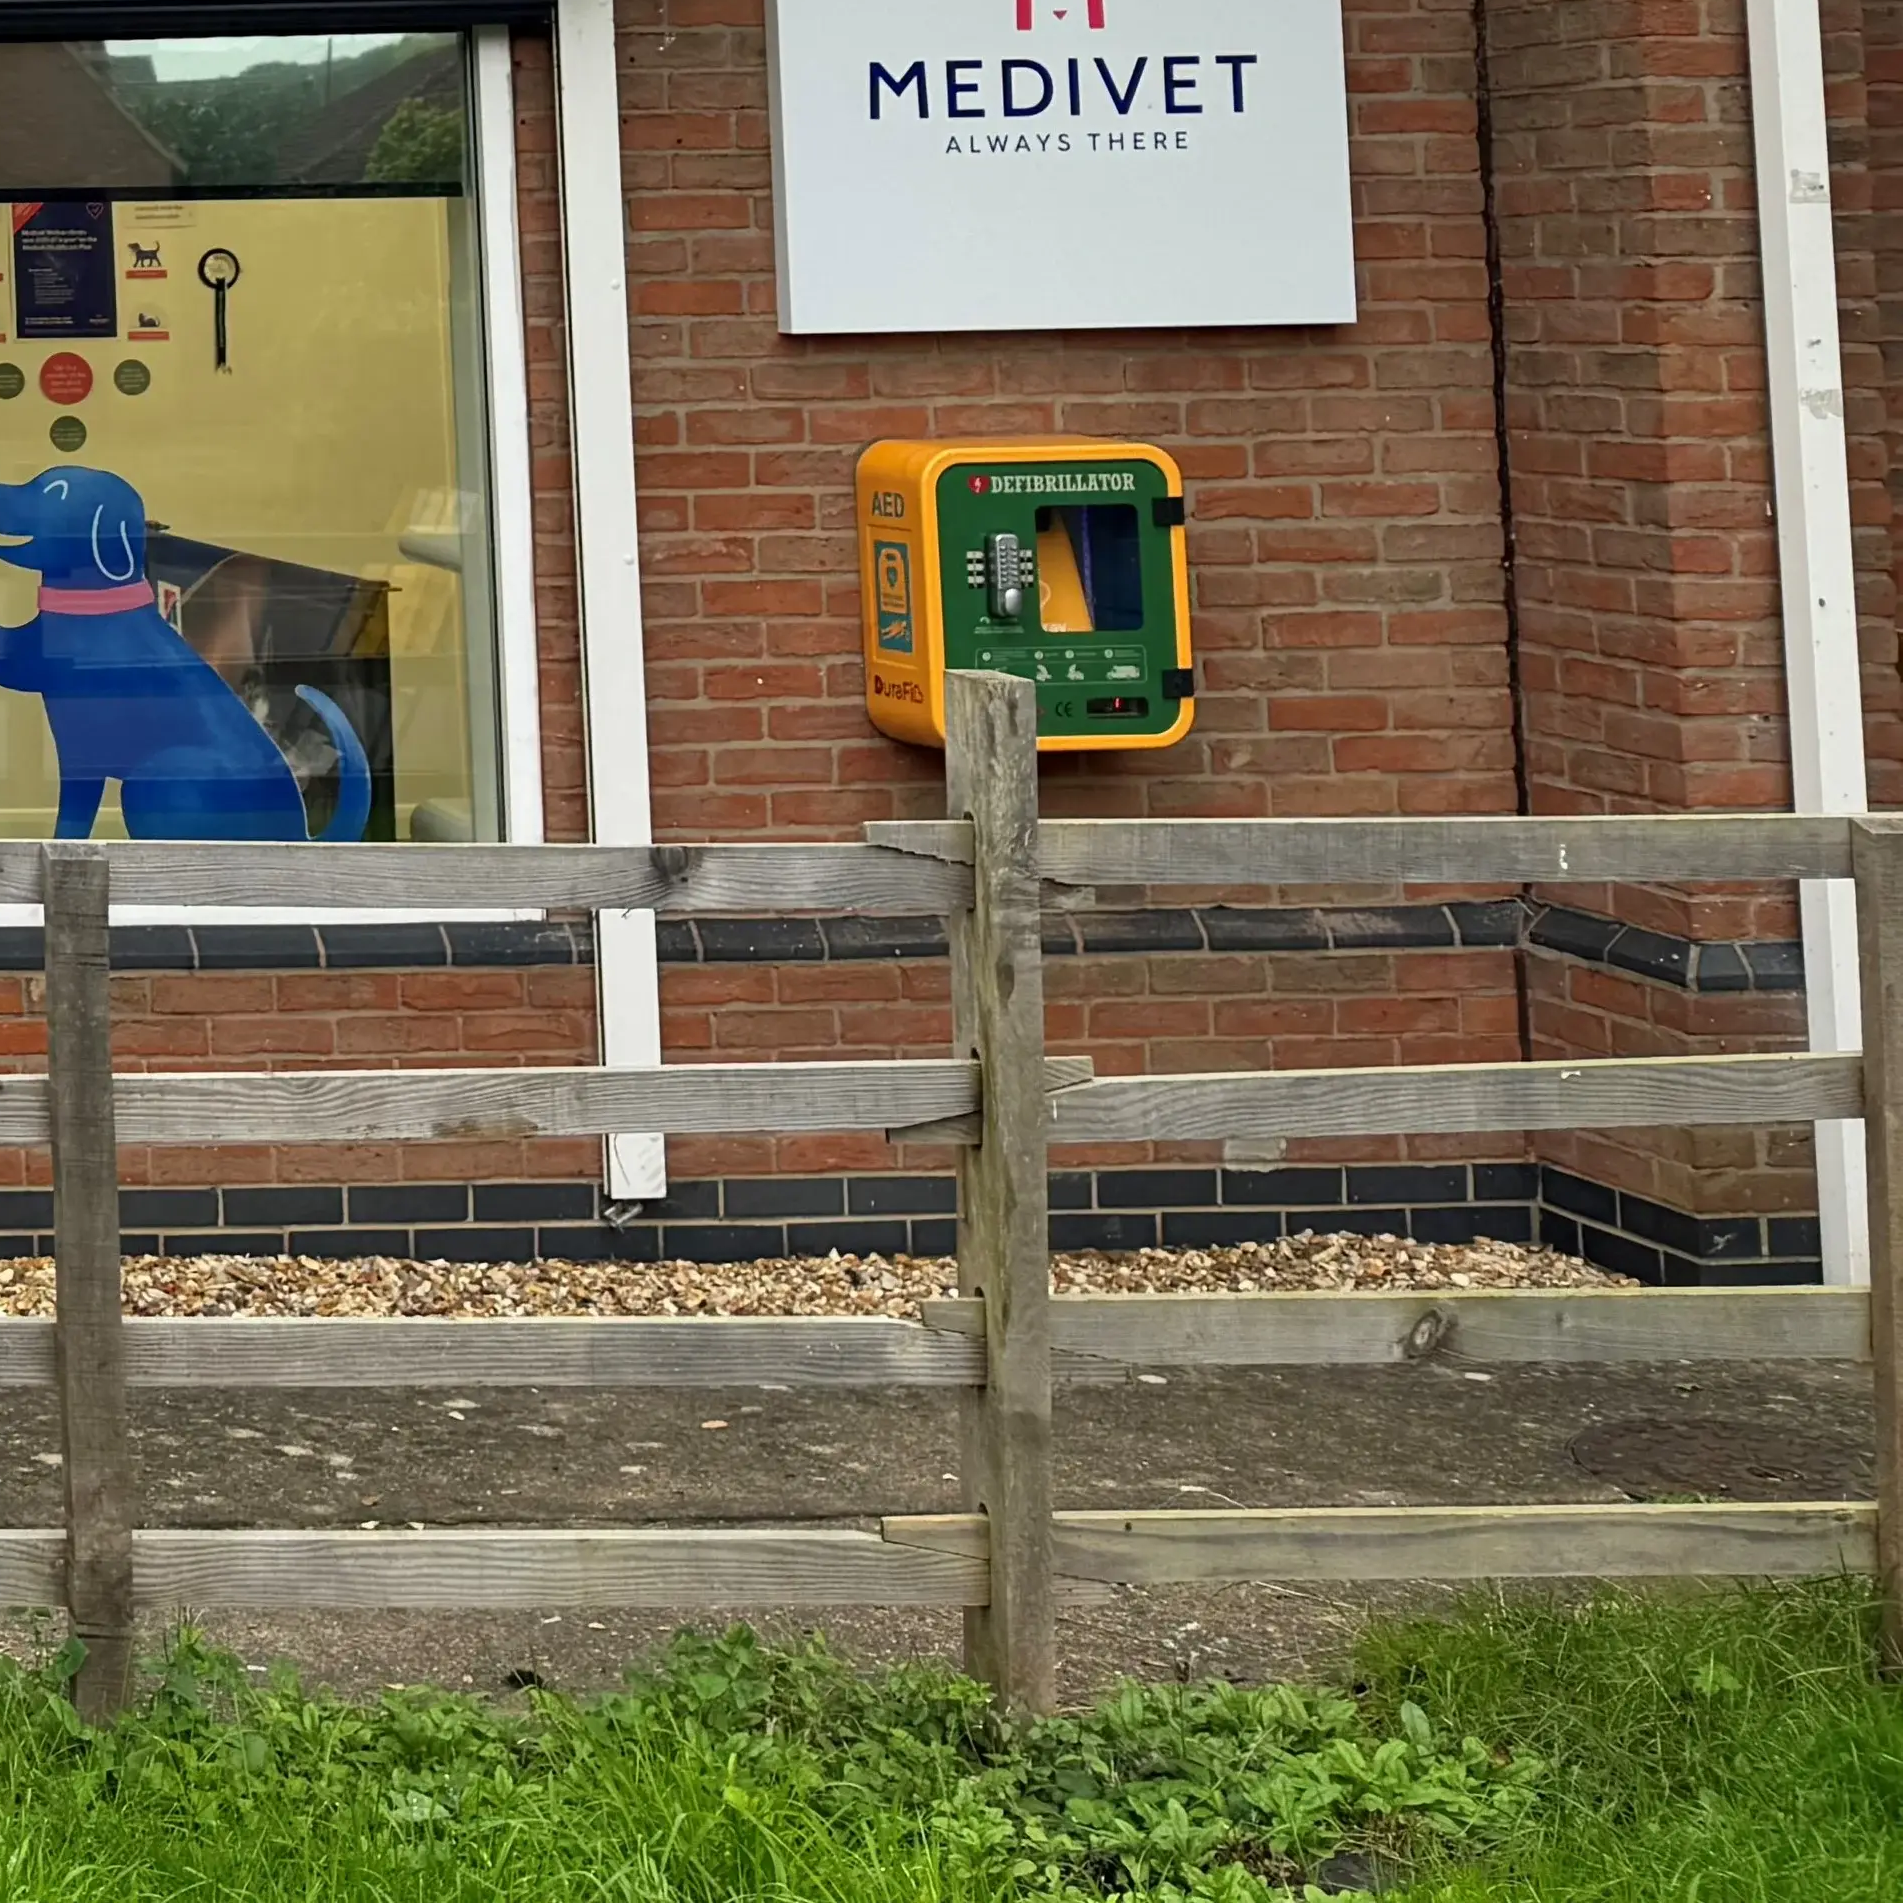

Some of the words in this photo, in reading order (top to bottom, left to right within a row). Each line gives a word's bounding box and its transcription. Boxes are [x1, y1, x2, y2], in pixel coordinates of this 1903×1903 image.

[869, 54, 1257, 120] MEDIVET
[945, 132, 1072, 154] ALWAYS
[1087, 129, 1190, 151] THERE
[991, 473, 1136, 494] DEFIBRILLATOR
[872, 491, 905, 518] AED
